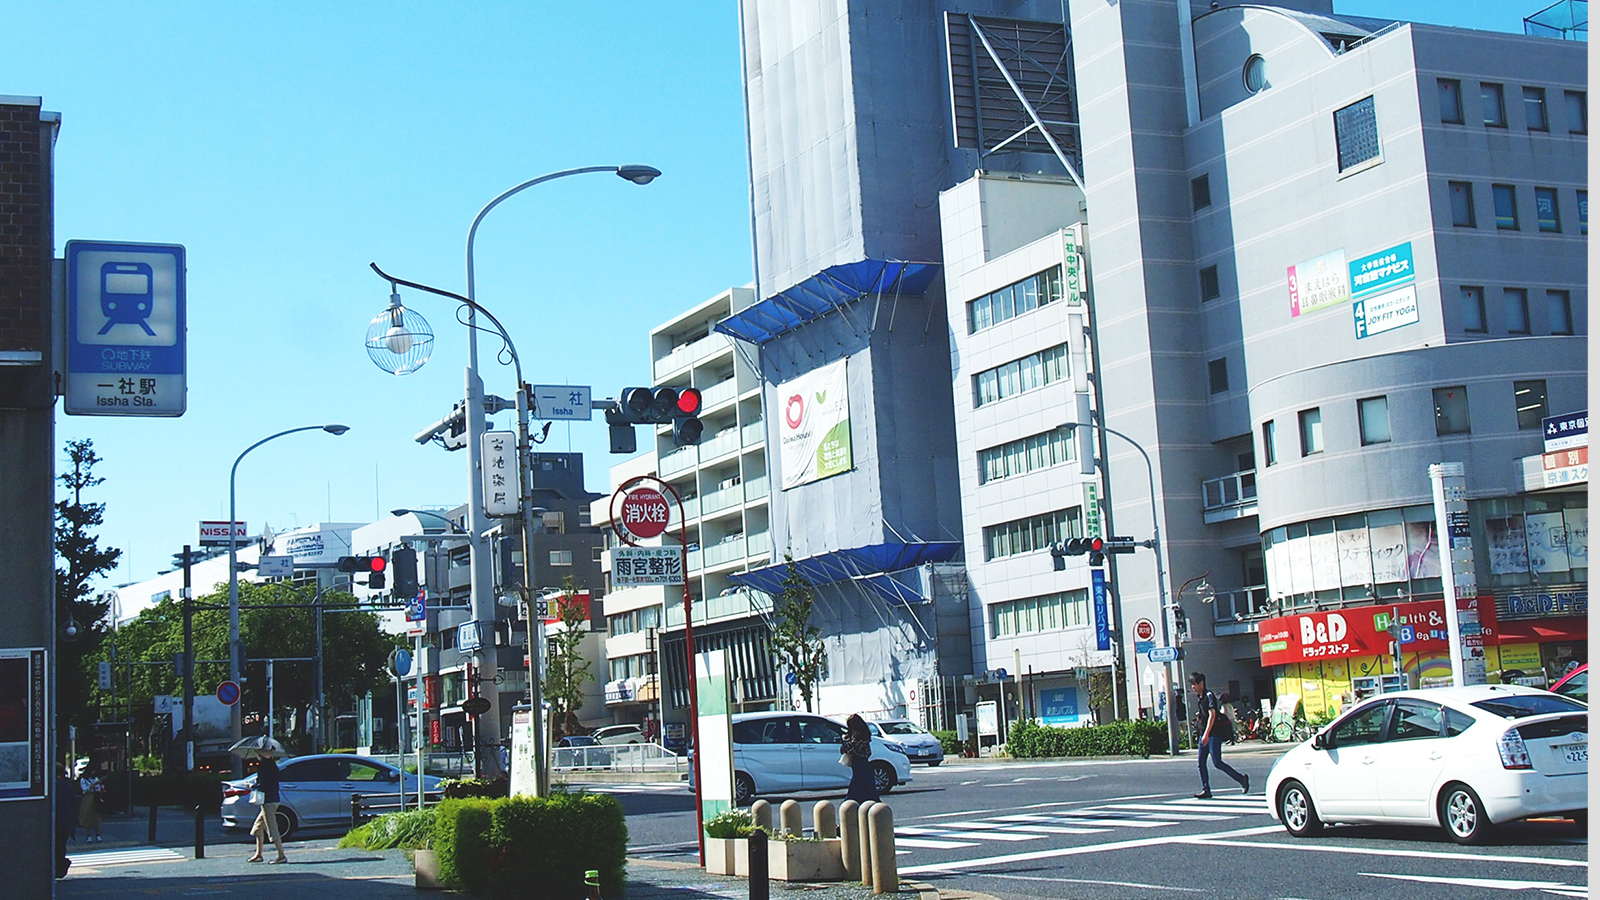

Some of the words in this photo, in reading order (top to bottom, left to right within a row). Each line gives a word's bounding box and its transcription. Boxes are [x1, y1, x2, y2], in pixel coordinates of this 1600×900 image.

[1064, 233, 1079, 302] 一社中央ビル
[1304, 272, 1340, 293] まえはら
[1367, 314, 1381, 325] JOY
[1382, 310, 1393, 321] FIT
[1395, 304, 1416, 317] YOGA
[116, 349, 152, 361] 地下鉄
[101, 361, 152, 371] SUBWAY
[97, 377, 156, 395] 一社駅
[97, 396, 129, 406] Issha
[133, 396, 157, 406] Sta.
[542, 391, 583, 406] 一社
[552, 407, 574, 416] Issha
[1544, 451, 1580, 469] 個別
[625, 503, 667, 523] 消火栓
[201, 528, 246, 536] NISSAN
[615, 556, 681, 576] 雨宮整形
[1508, 593, 1554, 614] B&D
[1095, 585, 1108, 642] 東急リバブル
[1376, 611, 1426, 631] Halth
[1428, 610, 1443, 626] &
[1299, 613, 1348, 646] B&D
[1401, 627, 1449, 641] Beaut
